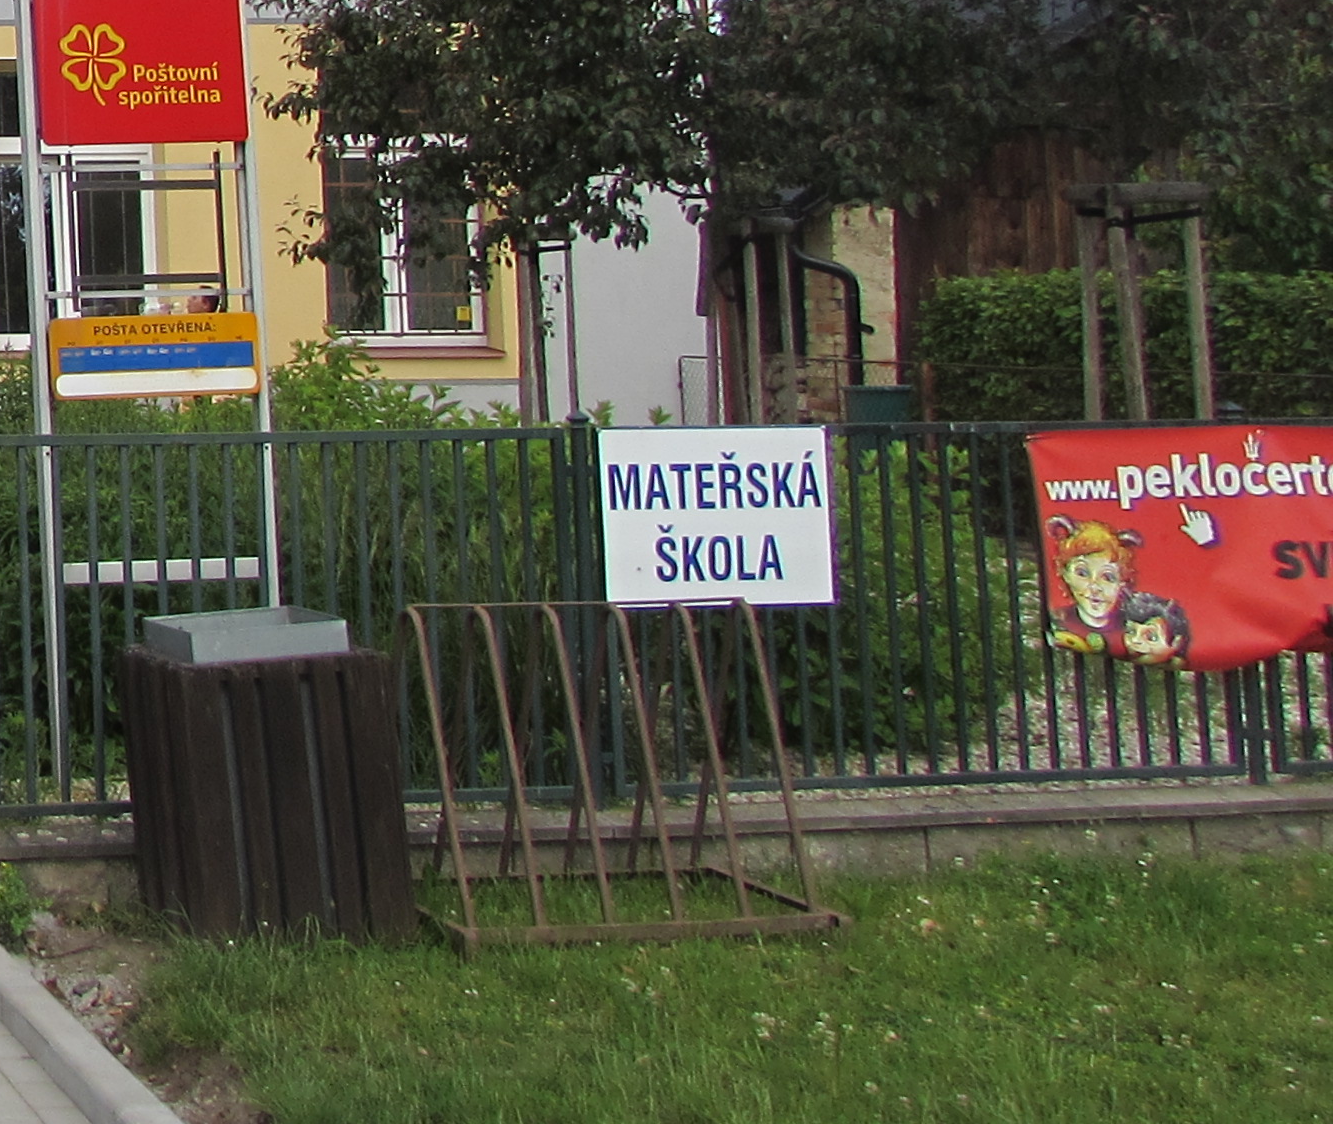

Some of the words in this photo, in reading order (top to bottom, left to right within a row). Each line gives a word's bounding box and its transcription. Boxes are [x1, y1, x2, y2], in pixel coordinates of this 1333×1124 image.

[132, 61, 219, 83] Poštovní
[118, 82, 222, 109] spořitelna
[93, 322, 138, 337] POŠTA
[141, 320, 217, 336] OTEVŘENA:
[607, 450, 823, 511] MATEŘSKÁ
[1045, 434, 1333, 509] www.pekločert
[654, 524, 785, 582] ŠKOLA
